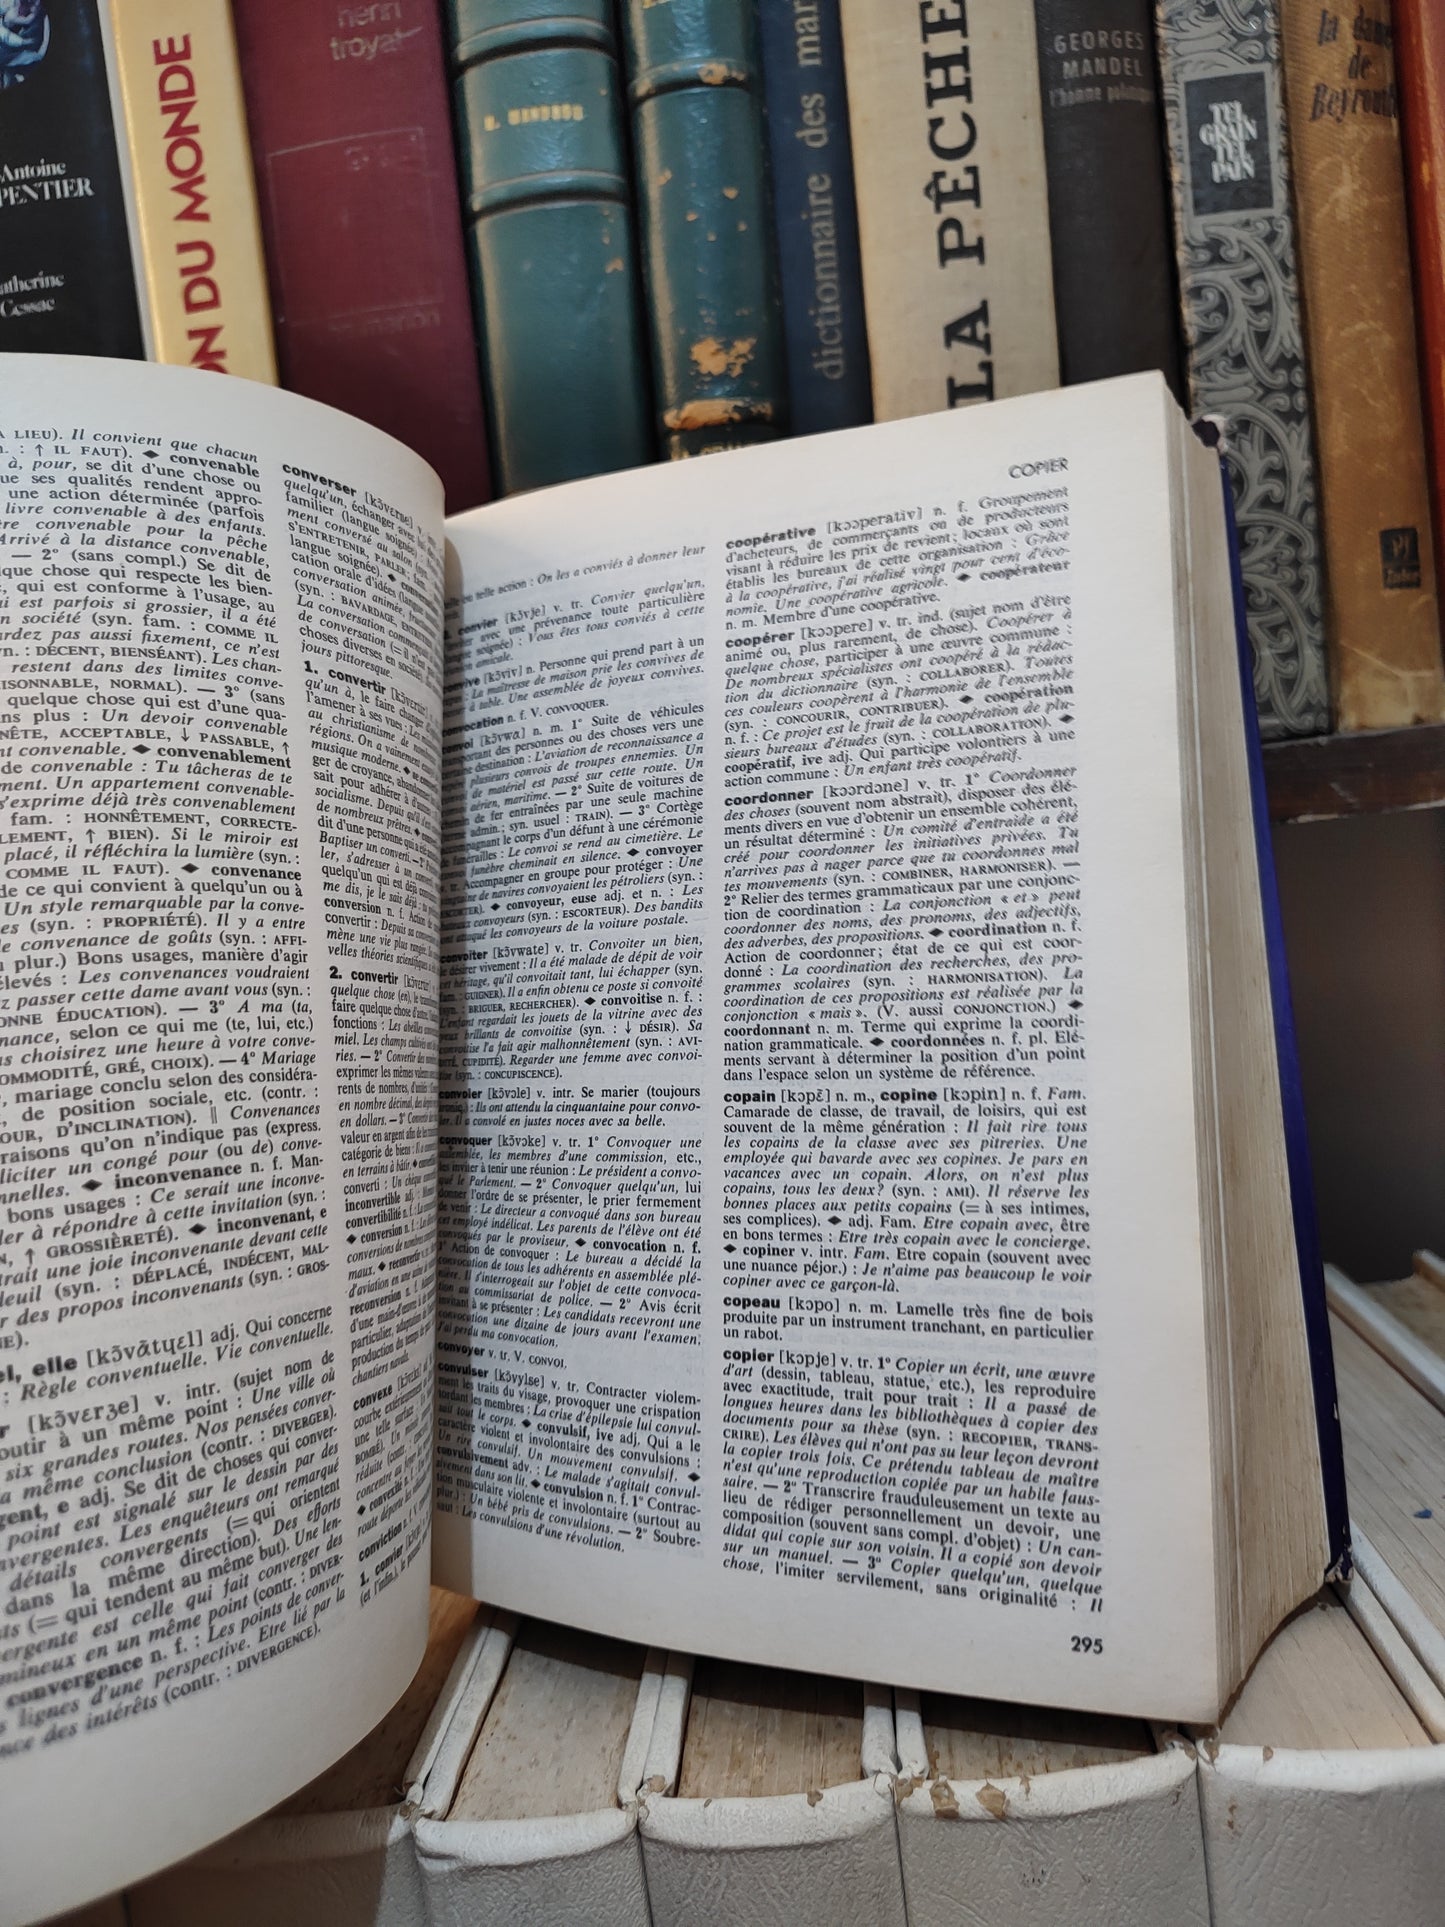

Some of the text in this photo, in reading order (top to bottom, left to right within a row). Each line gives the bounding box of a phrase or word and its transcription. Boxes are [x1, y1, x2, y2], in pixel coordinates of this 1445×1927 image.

[1054, 30, 1145, 54] GEORGES
[1318, 8, 1338, 47] la
[1063, 55, 1144, 80] MANDEL
[1348, 45, 1372, 80] de
[795, 92, 829, 149] des
[1208, 100, 1242, 122] TEL
[152, 33, 211, 222] MONDE
[1199, 114, 1258, 148] GRAIN
[0, 158, 67, 184] Antoine
[1211, 153, 1255, 183] PAIN
[918, 0, 995, 409] LA PÊCHE
[176, 240, 222, 315] DU
[806, 172, 844, 381] dictionnaire
[14, 428, 258, 463] LIEU). Il convient que chacun
[54, 445, 260, 478] IL FAUT). convenable
[1008, 457, 1069, 480] COPIER
[282, 463, 357, 498] converser
[5, 502, 266, 537] livre convenable à des enfants.
[726, 526, 816, 549] coopérative
[726, 592, 940, 631] n. m. Membre d'une coopérative.
[539, 636, 704, 672] Personne qui prend part à un
[304, 660, 387, 695] 1. convertir
[724, 788, 814, 806] coordonner
[4, 843, 291, 865] placé, il réfléchira la lumière (syn.
[5, 861, 302, 881] COMME IL FAUT). convenance
[723, 1064, 1035, 1082] dans l'espace selon un système de référence.
[537, 1090, 546, 1099] v.
[553, 1087, 574, 1099] intr.
[581, 1086, 594, 1099] Se
[601, 1085, 639, 1098] marier
[647, 1085, 701, 1099] (toujours
[723, 1090, 776, 1105] copain
[836, 1092, 848, 1102] n.
[881, 1087, 937, 1104] copine
[1011, 1090, 1025, 1100] n.
[1031, 1087, 1041, 1100] f.
[1048, 1087, 1086, 1100] Fam.
[473, 1114, 666, 1128] convolé en justes noces avec sa belle.
[723, 1103, 1087, 1119] Camarade de classe, de travail, de loisirs, qui est
[439, 1135, 492, 1147] convoquer
[114, 1154, 323, 1189] inconvenance n. f. Man-
[469, 1175, 516, 1189] Parlement.
[552, 1178, 612, 1193] Convoquer
[618, 1180, 679, 1195] quelqu'un,
[685, 1181, 701, 1193] lui
[217, 1208, 327, 1233] inconvenant, e
[593, 1239, 666, 1252] convocation
[723, 1296, 780, 1309] copeau
[210, 1305, 332, 1343] adj. Qui concerne
[723, 1311, 1094, 1341] produite par un instrument tranchant, en particulier
[723, 1327, 782, 1341] un rabot.
[723, 1348, 774, 1364] copier
[723, 1393, 1098, 1436] longues heures dans les bibliothèques à copier des
[723, 1556, 1102, 1612] chose, l'imiter servilement, sans originalité Il
[154, 1638, 250, 1689] perspective.
[259, 1620, 286, 1643] Etre
[293, 1605, 307, 1626] lié
[313, 1596, 331, 1619] par
[1071, 1635, 1103, 1655] 295
[163, 1620, 321, 1704] (contr. DIVERGENCE).
